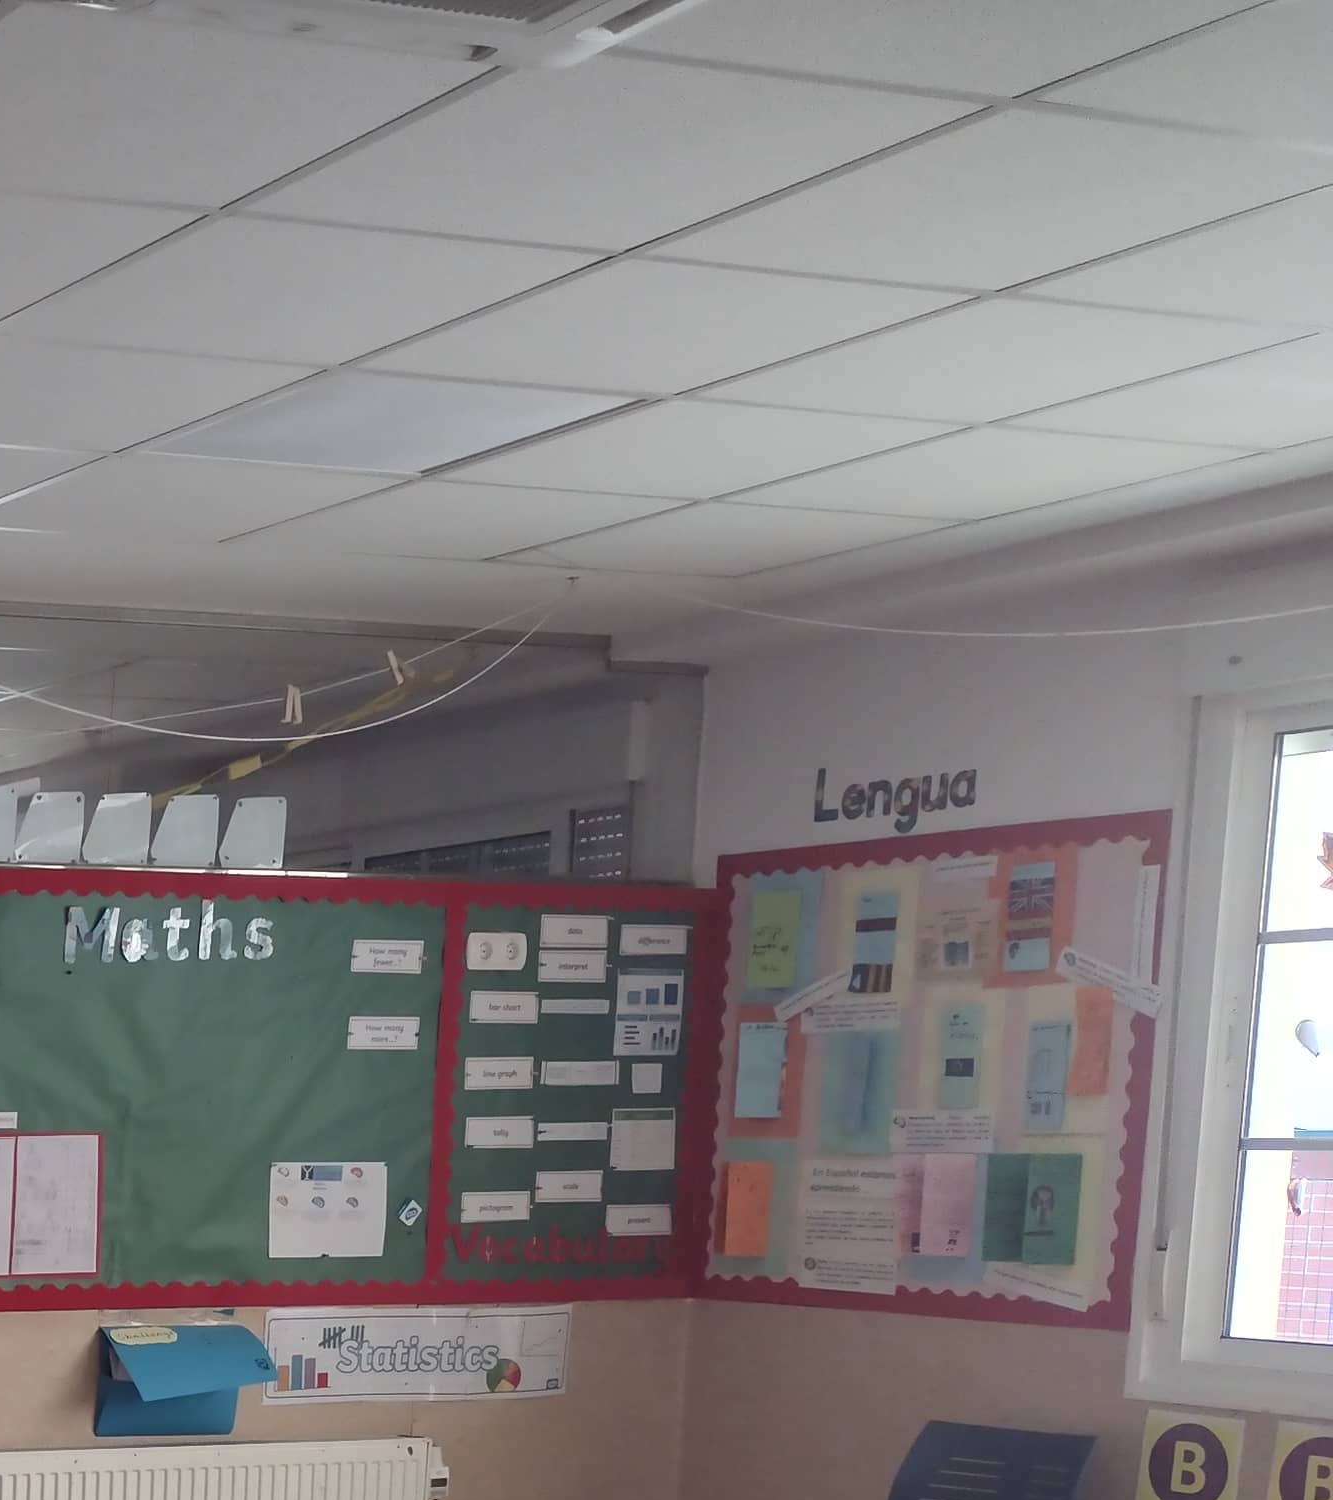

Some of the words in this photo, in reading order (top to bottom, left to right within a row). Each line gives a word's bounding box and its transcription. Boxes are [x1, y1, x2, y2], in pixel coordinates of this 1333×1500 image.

[814, 767, 977, 834] Lengua
[64, 899, 275, 963] Maths
[450, 1223, 672, 1264] Vocabular
[336, 1336, 501, 1374] Statistics
[1171, 1440, 1206, 1494] B
